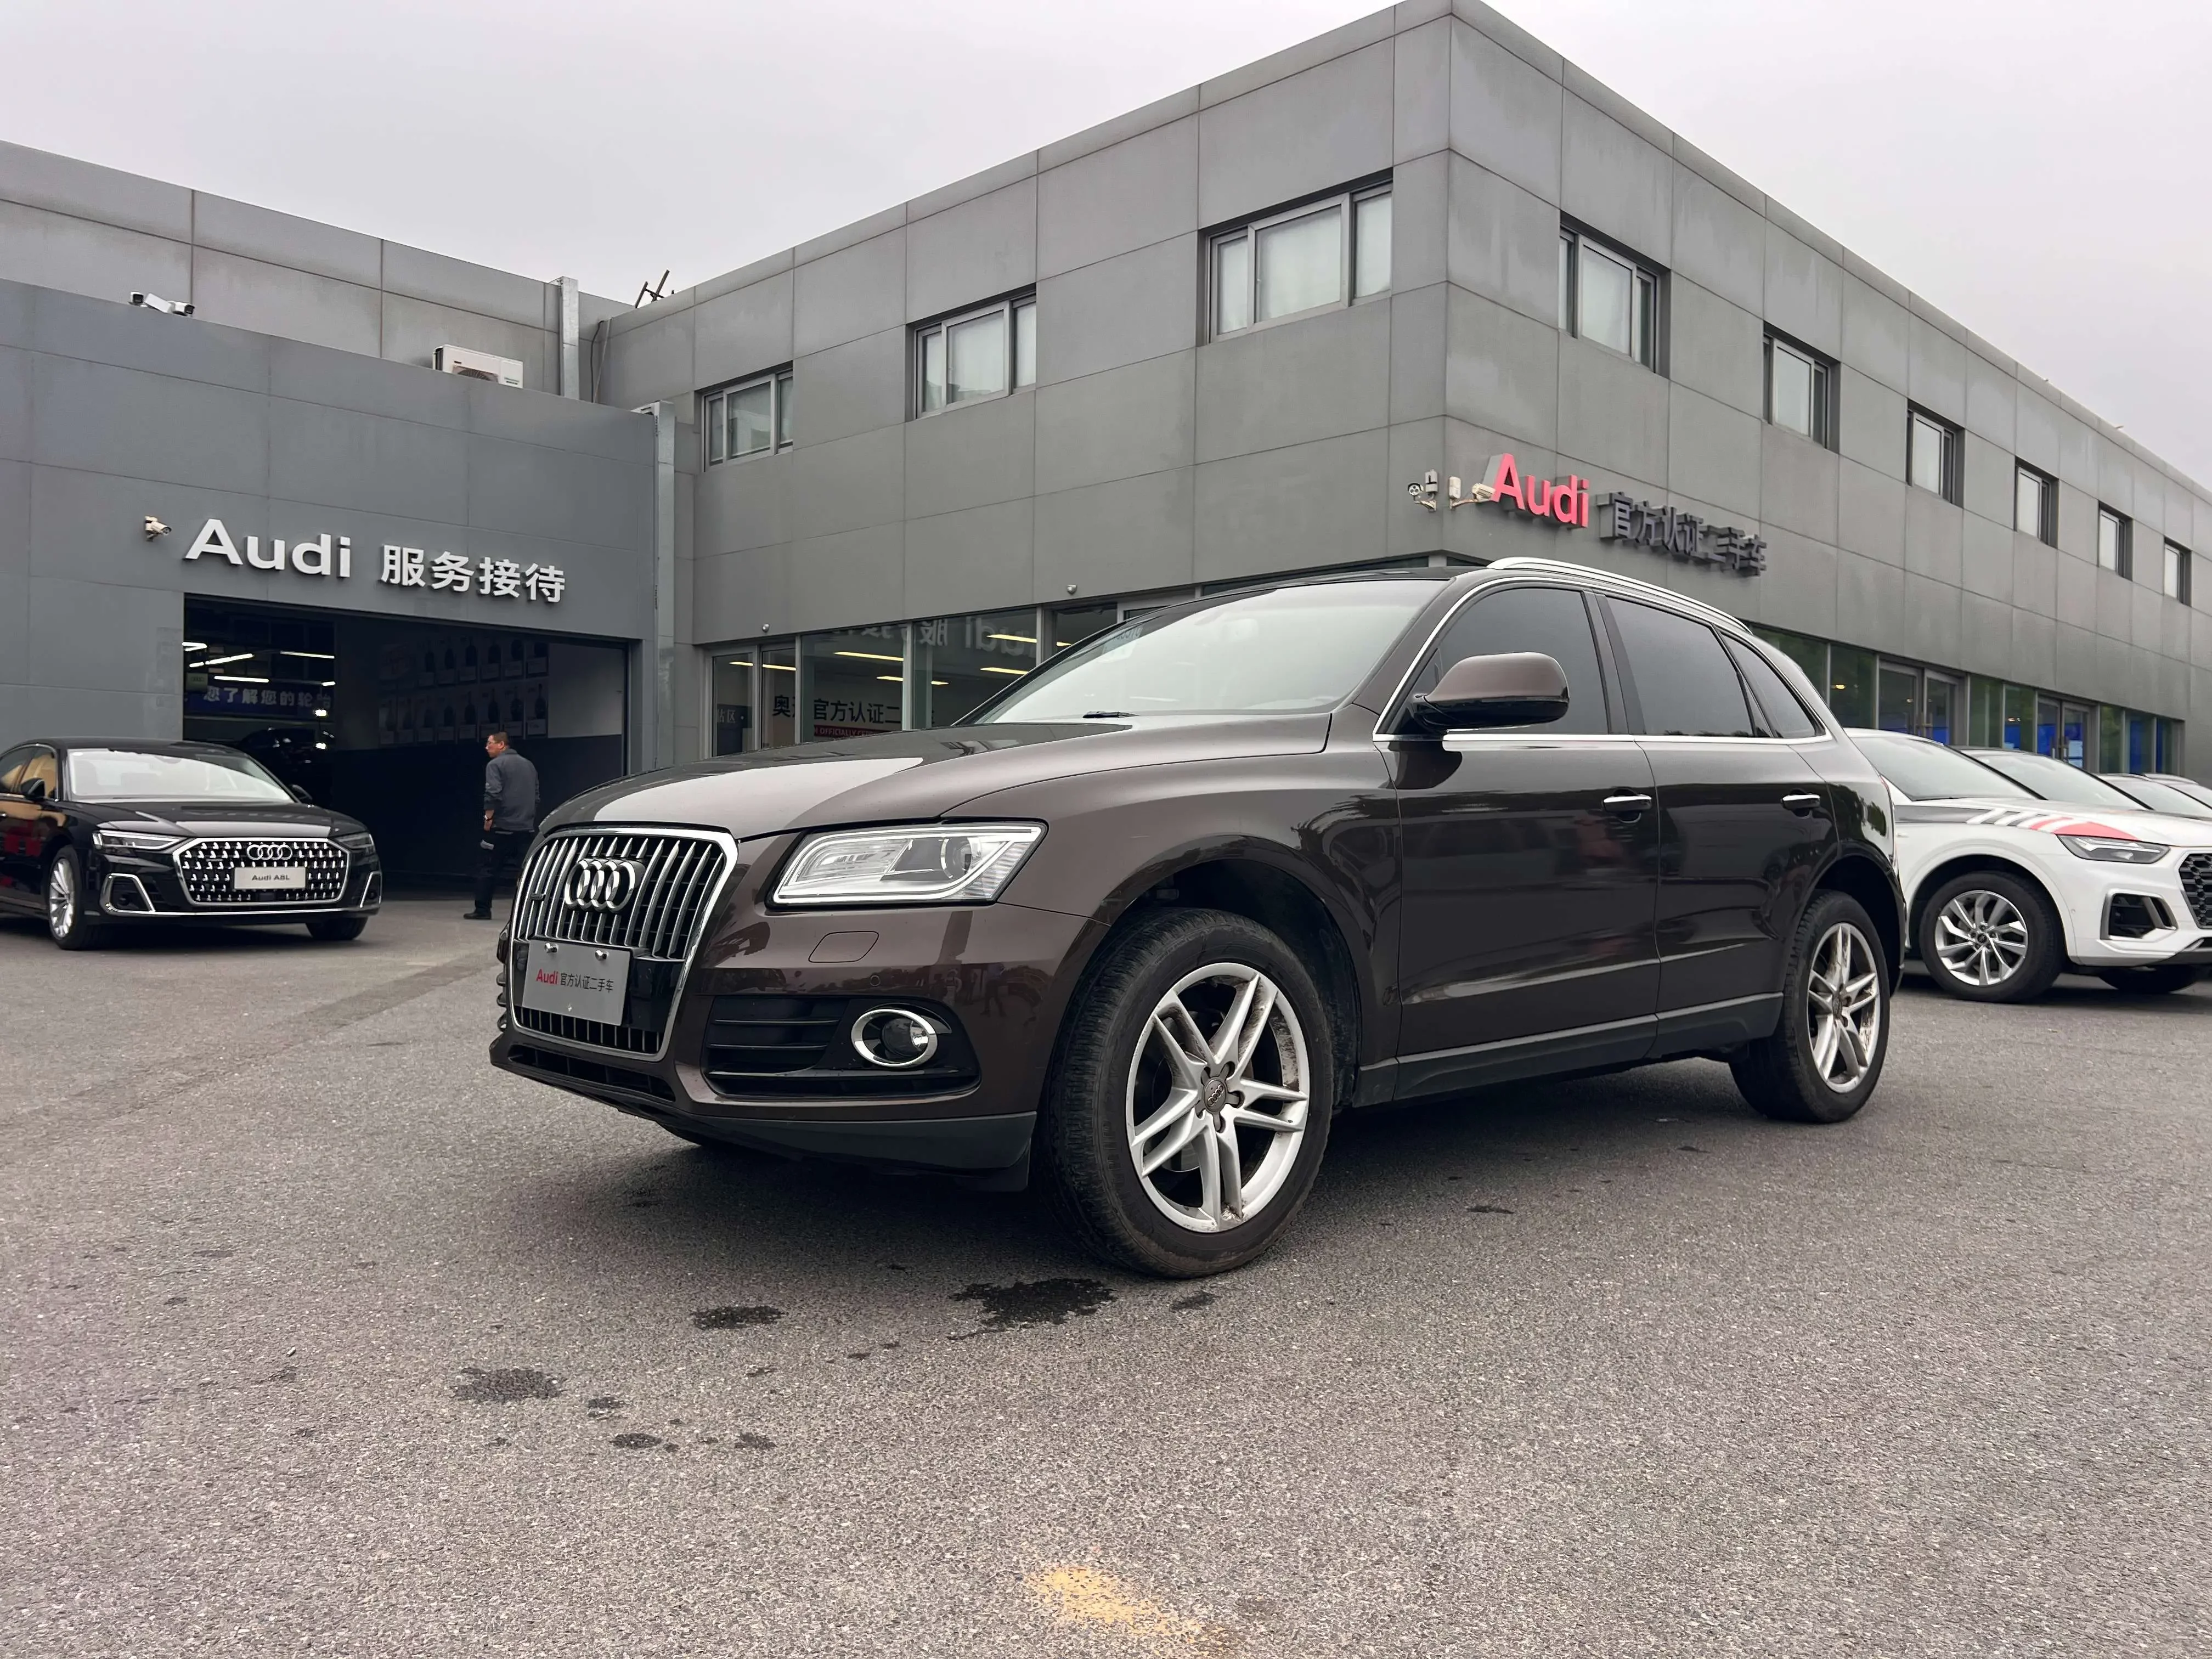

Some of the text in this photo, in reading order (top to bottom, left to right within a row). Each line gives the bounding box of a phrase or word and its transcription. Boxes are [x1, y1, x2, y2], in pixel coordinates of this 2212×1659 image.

[1488, 453, 1767, 575] Audi 官方认证二手车
[184, 518, 566, 603] Audi 服务接待
[535, 968, 614, 993] Audi 官方认证二手车
